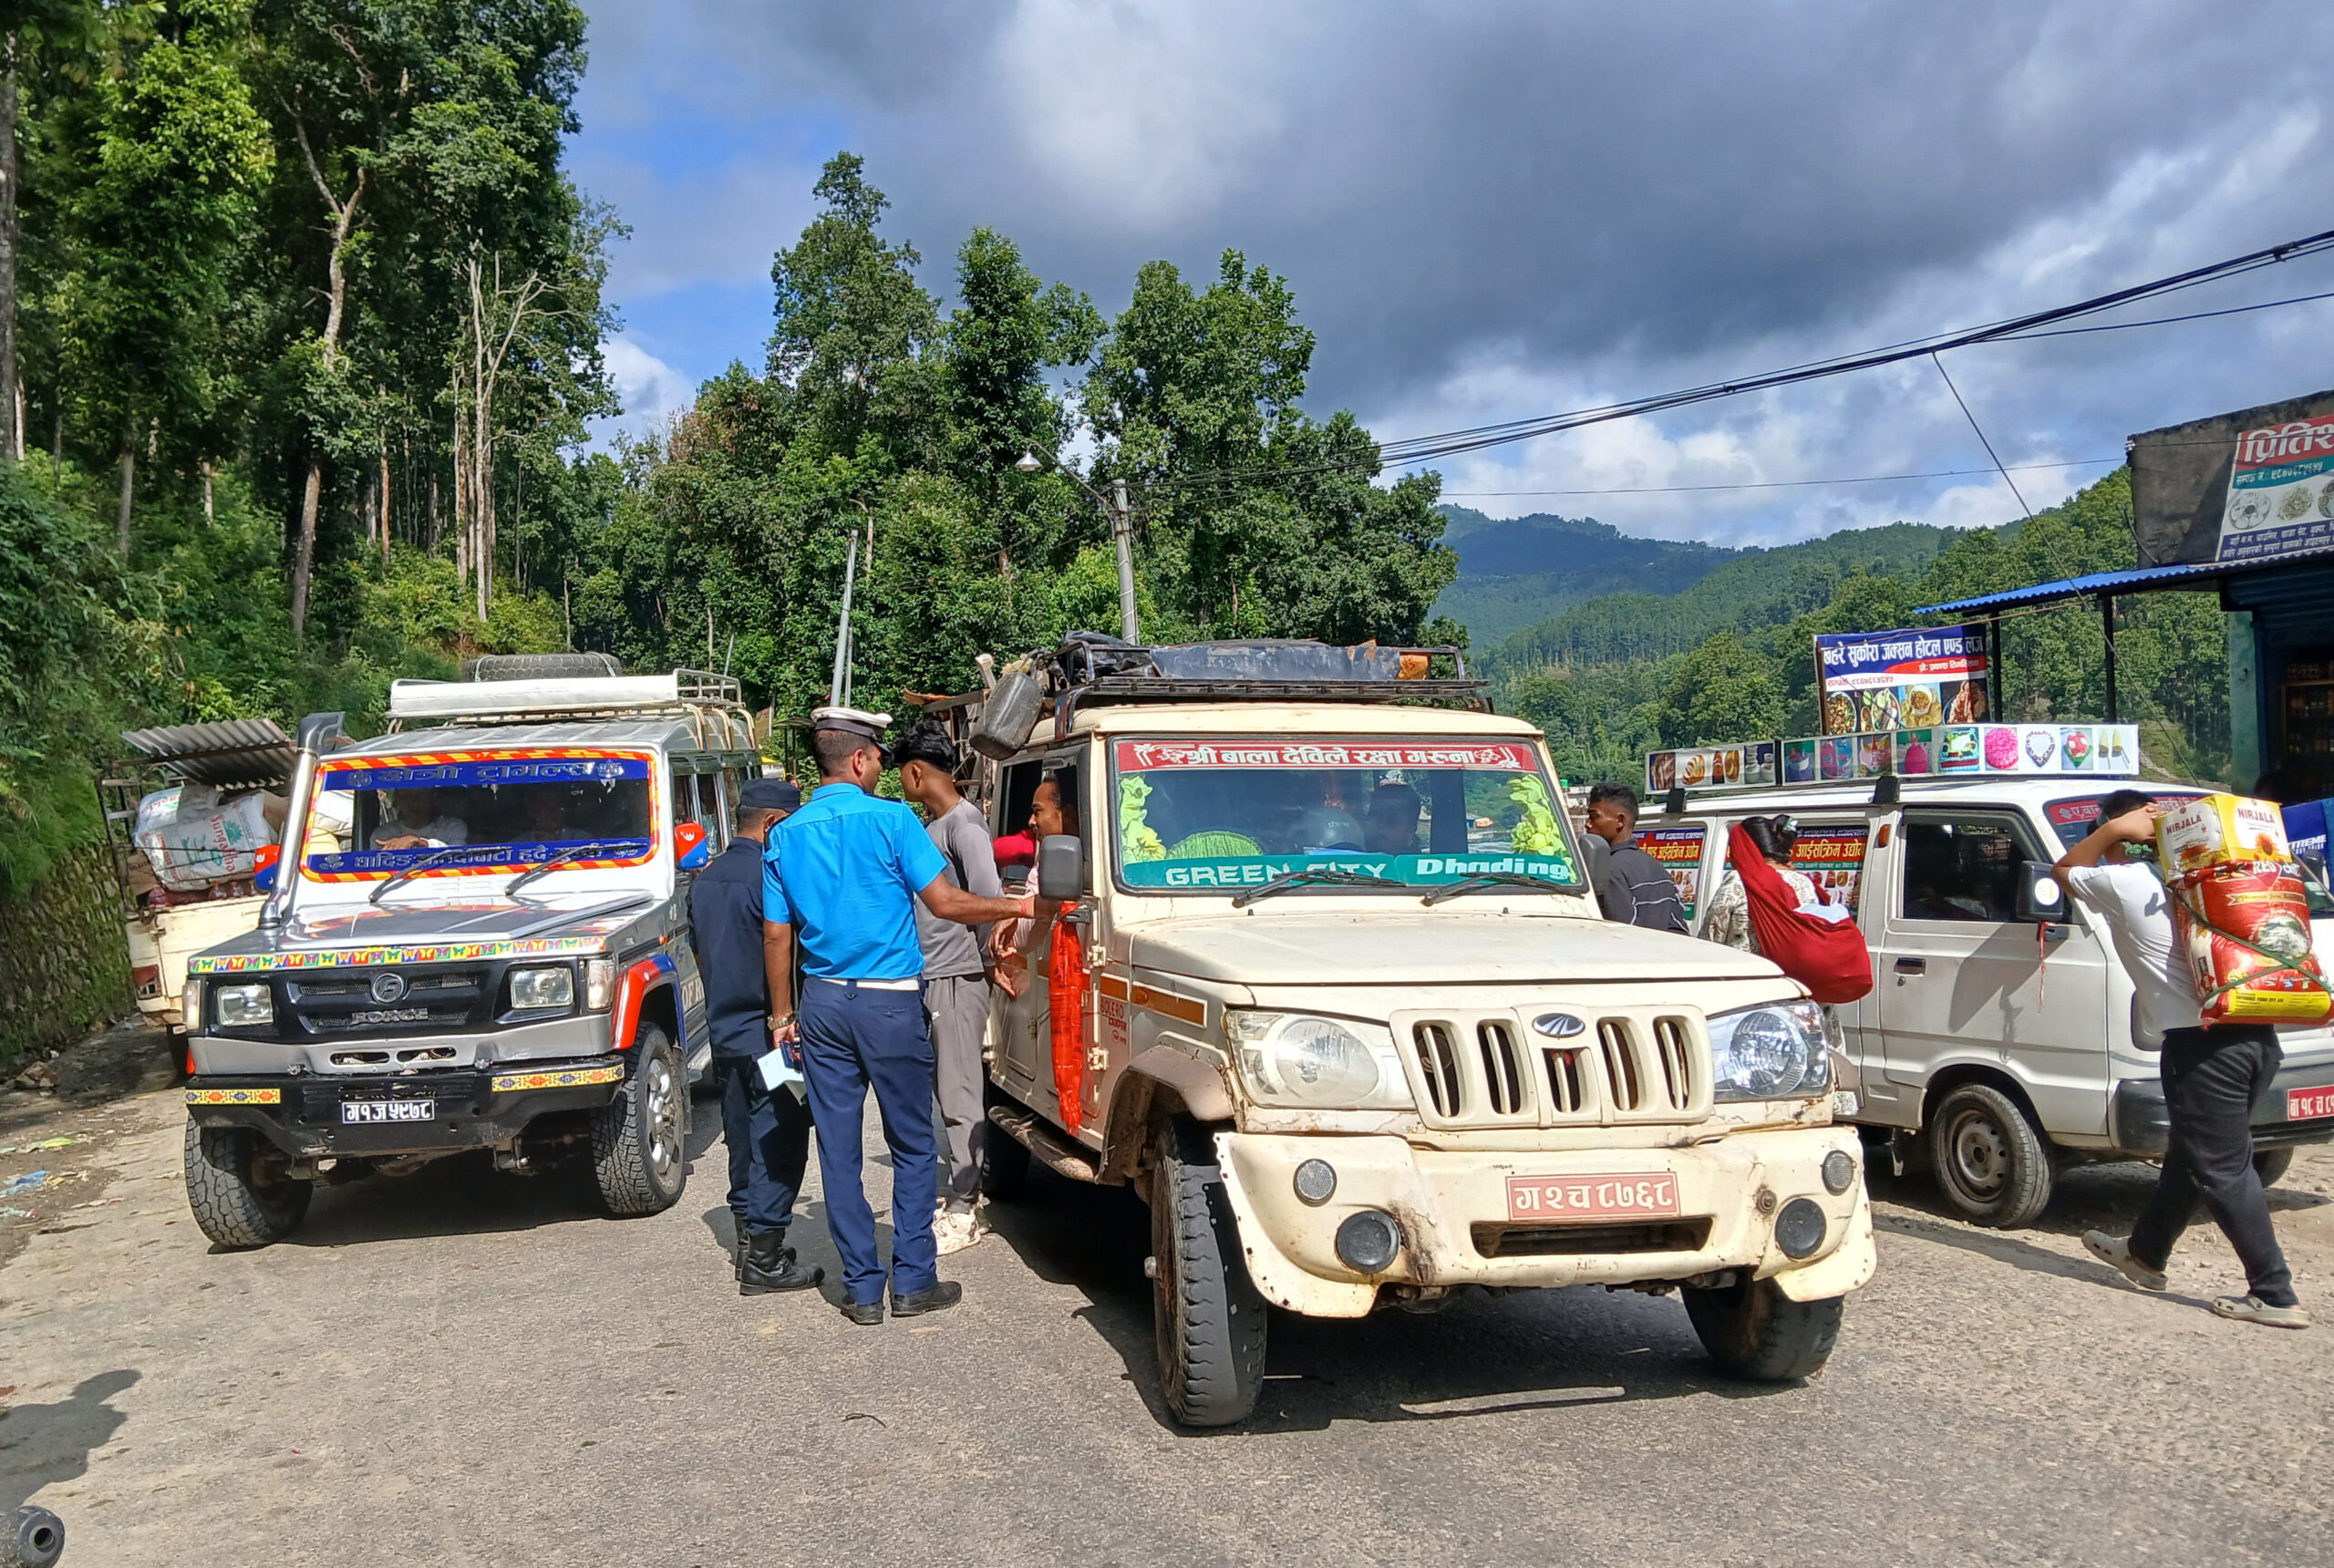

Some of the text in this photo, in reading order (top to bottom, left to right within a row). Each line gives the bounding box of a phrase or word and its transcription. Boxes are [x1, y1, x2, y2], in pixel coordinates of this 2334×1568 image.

[1915, 635, 1942, 659] होटल
[1943, 637, 1963, 655] एण्ड
[1965, 635, 1984, 654] लज
[1184, 744, 1216, 765] श्री
[1221, 749, 1280, 766] बाला
[1352, 749, 1404, 766] रक्षा
[2165, 814, 2203, 835] NIRJALA
[2236, 807, 2276, 824] NIRJALA
[1165, 862, 1290, 886] GREEN
[1416, 858, 1571, 881] Dhading
[350, 1007, 429, 1026] FORCE
